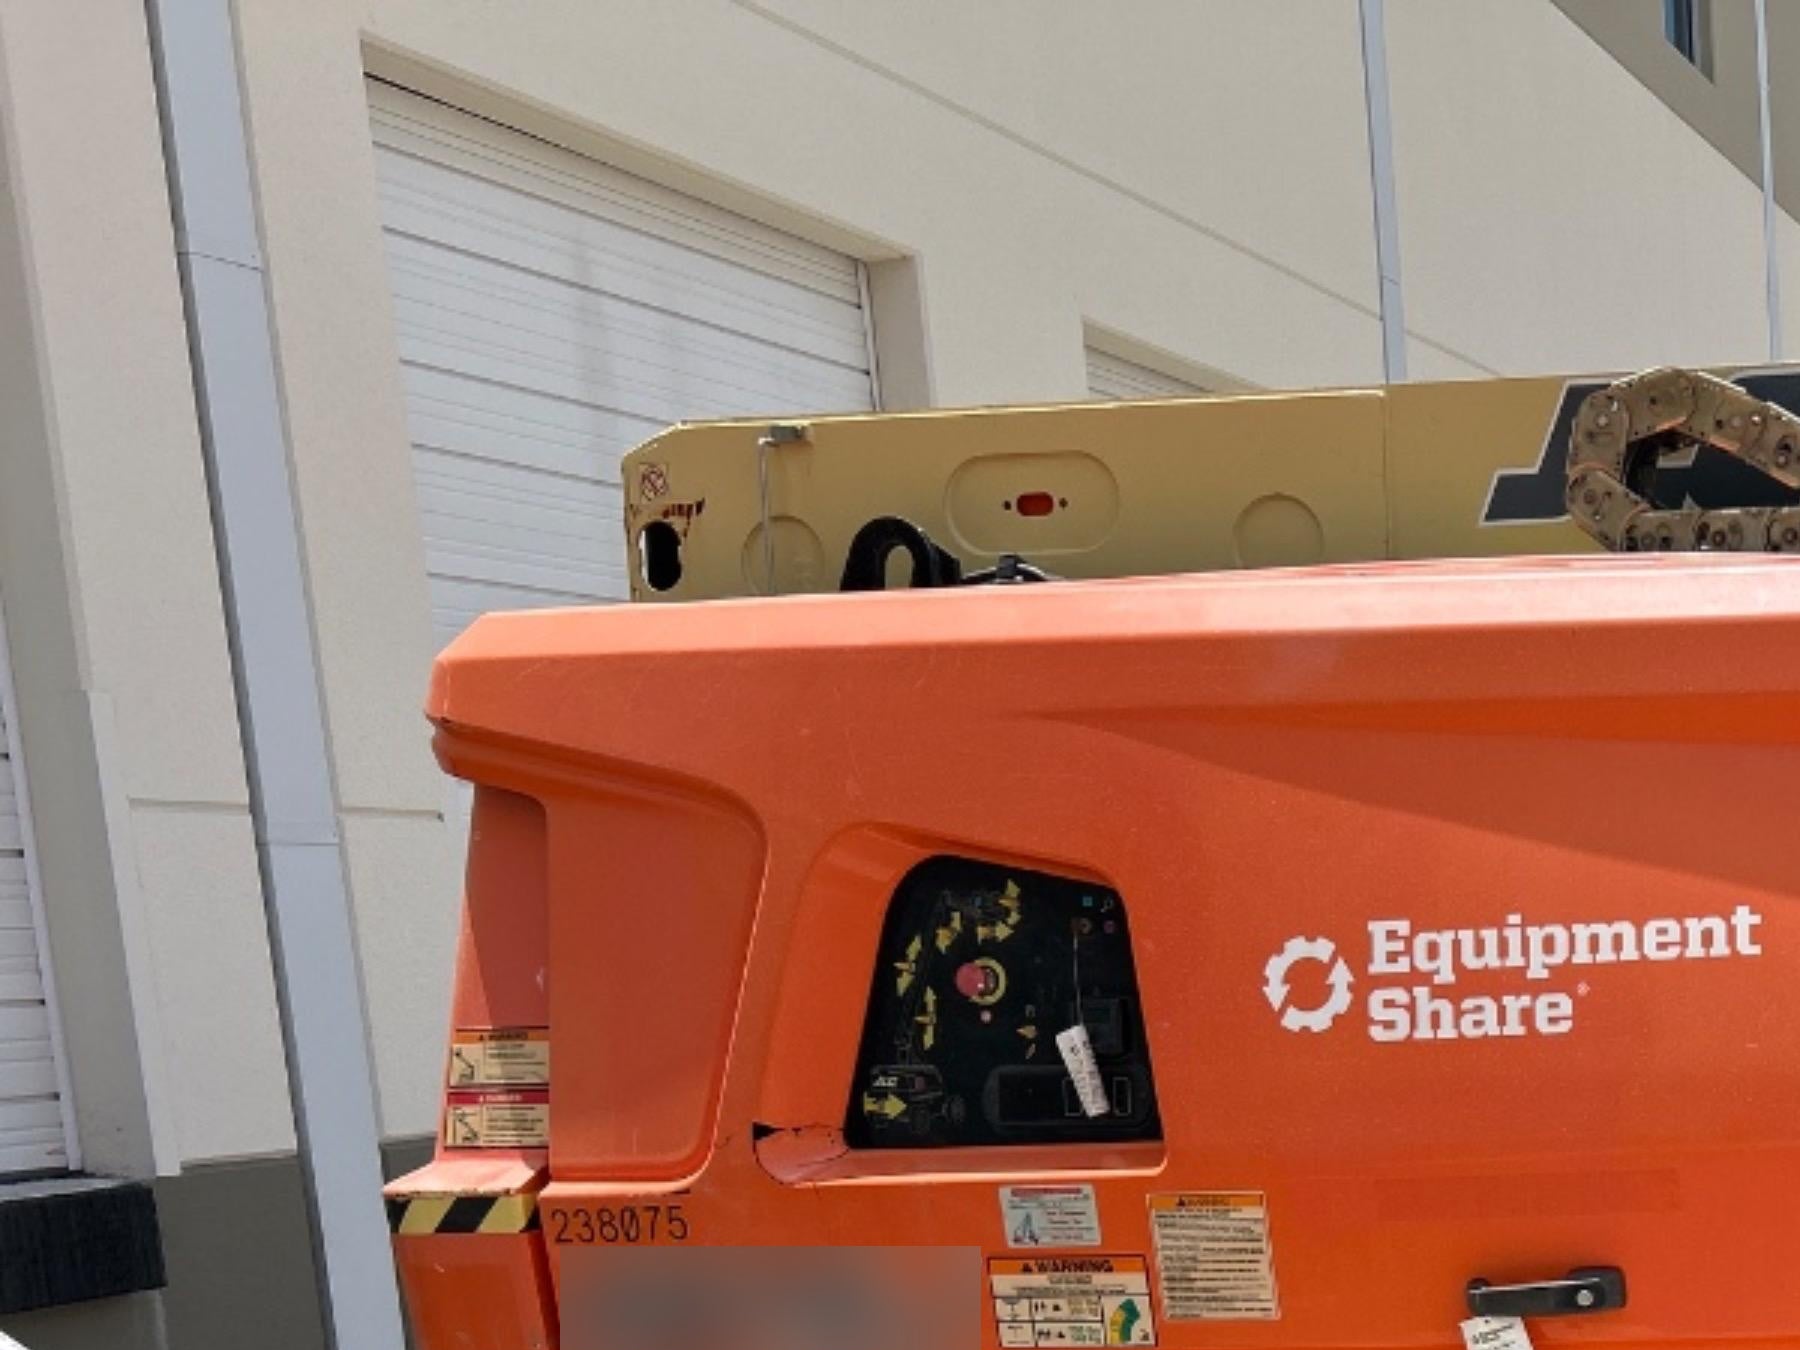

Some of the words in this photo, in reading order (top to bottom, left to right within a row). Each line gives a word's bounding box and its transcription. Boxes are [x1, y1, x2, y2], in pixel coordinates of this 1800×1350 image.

[1366, 905, 1763, 984] Equipment
[1366, 985, 1574, 1042] Share
[551, 1205, 688, 1243] 238075
[1036, 1259, 1115, 1273] WARNING
